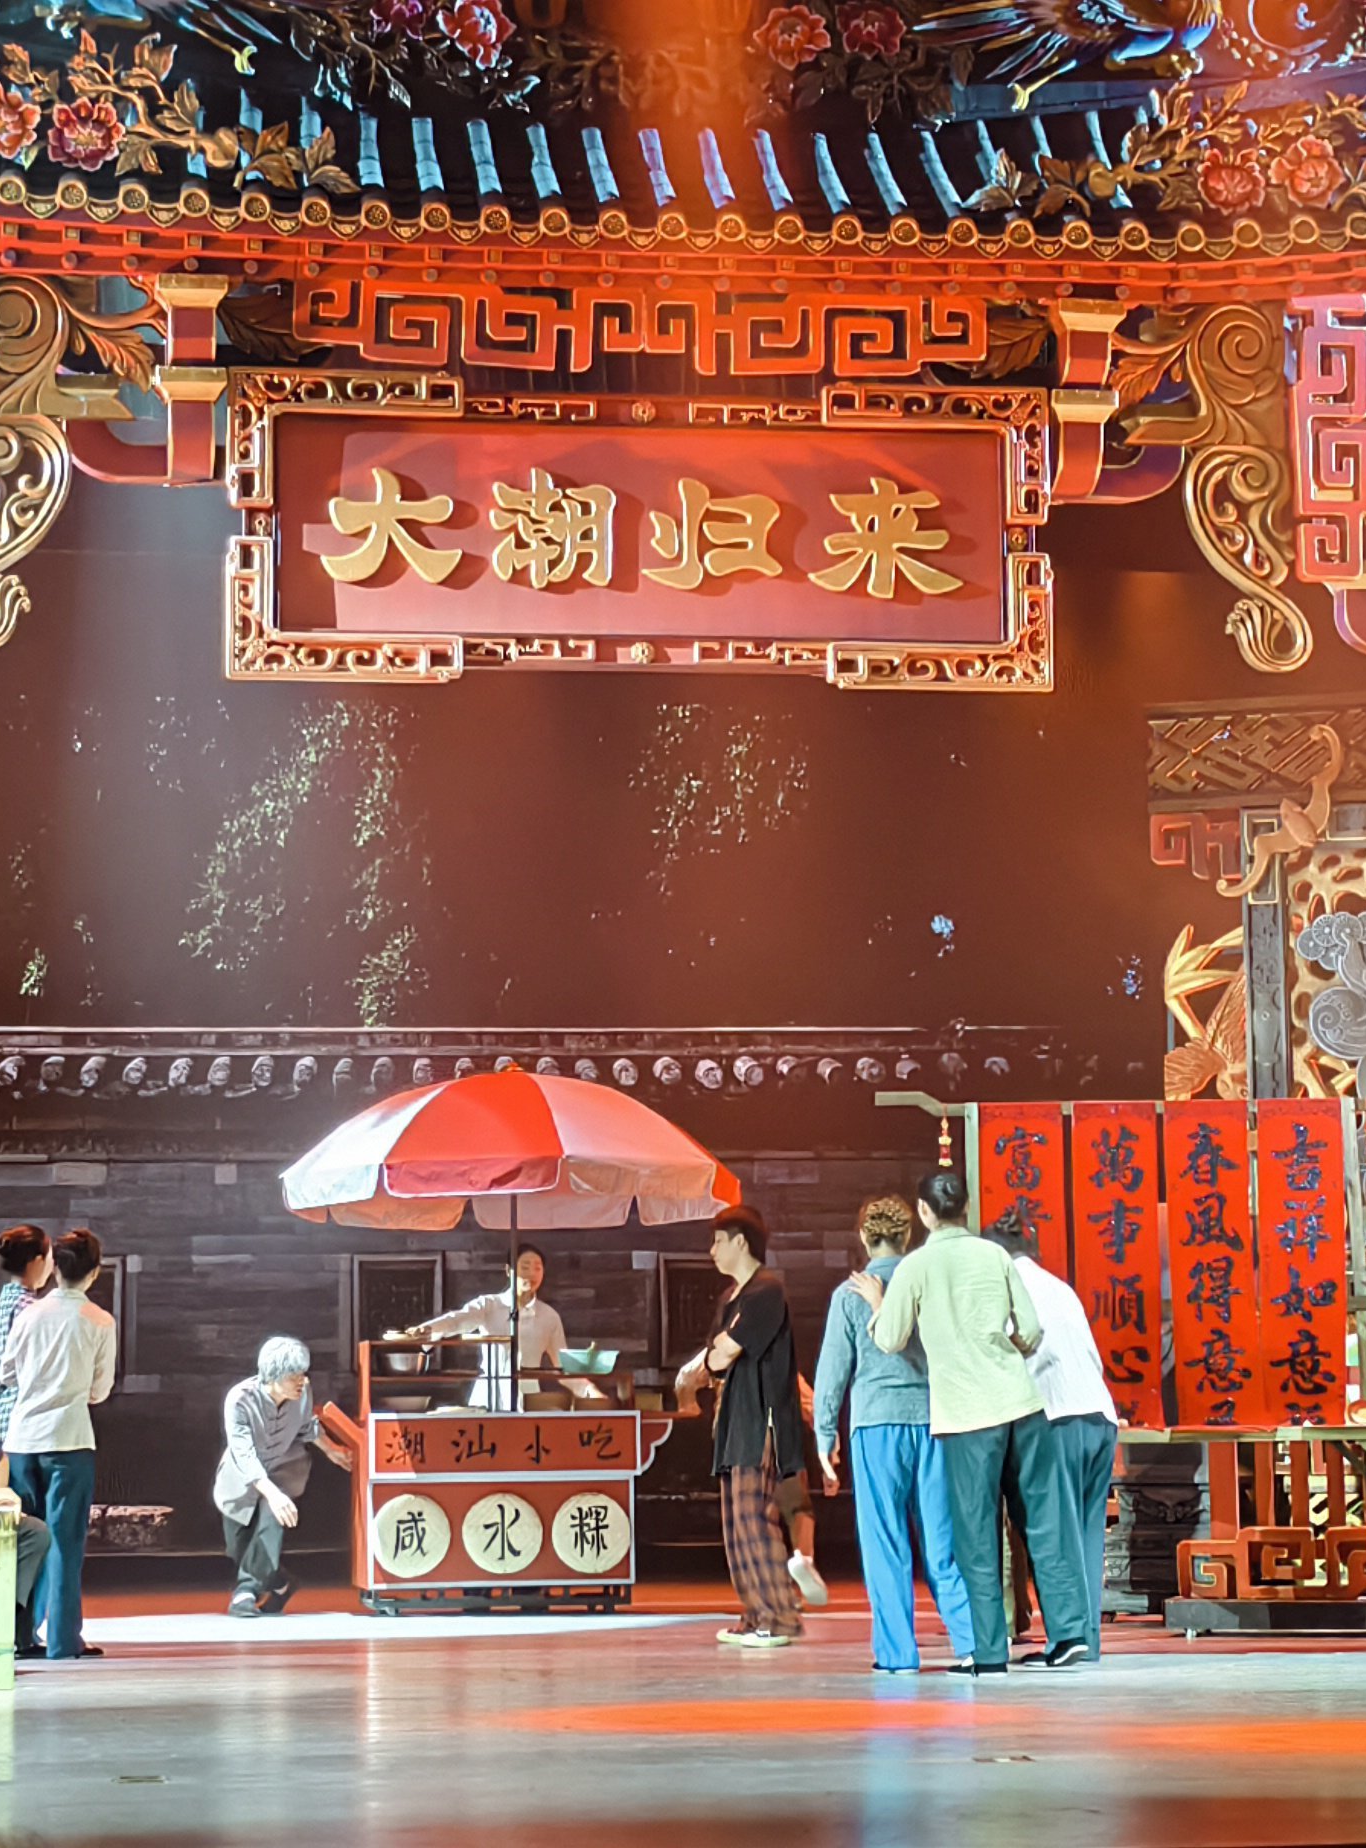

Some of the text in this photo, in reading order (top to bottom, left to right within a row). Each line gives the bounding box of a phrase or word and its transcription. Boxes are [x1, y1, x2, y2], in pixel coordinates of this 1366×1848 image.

[316, 467, 964, 599] 大潮归来
[1087, 1125, 1151, 1425] 萬事順心
[384, 1423, 622, 1465] 潮汕小吃
[392, 1503, 610, 1560] 咸水粿
